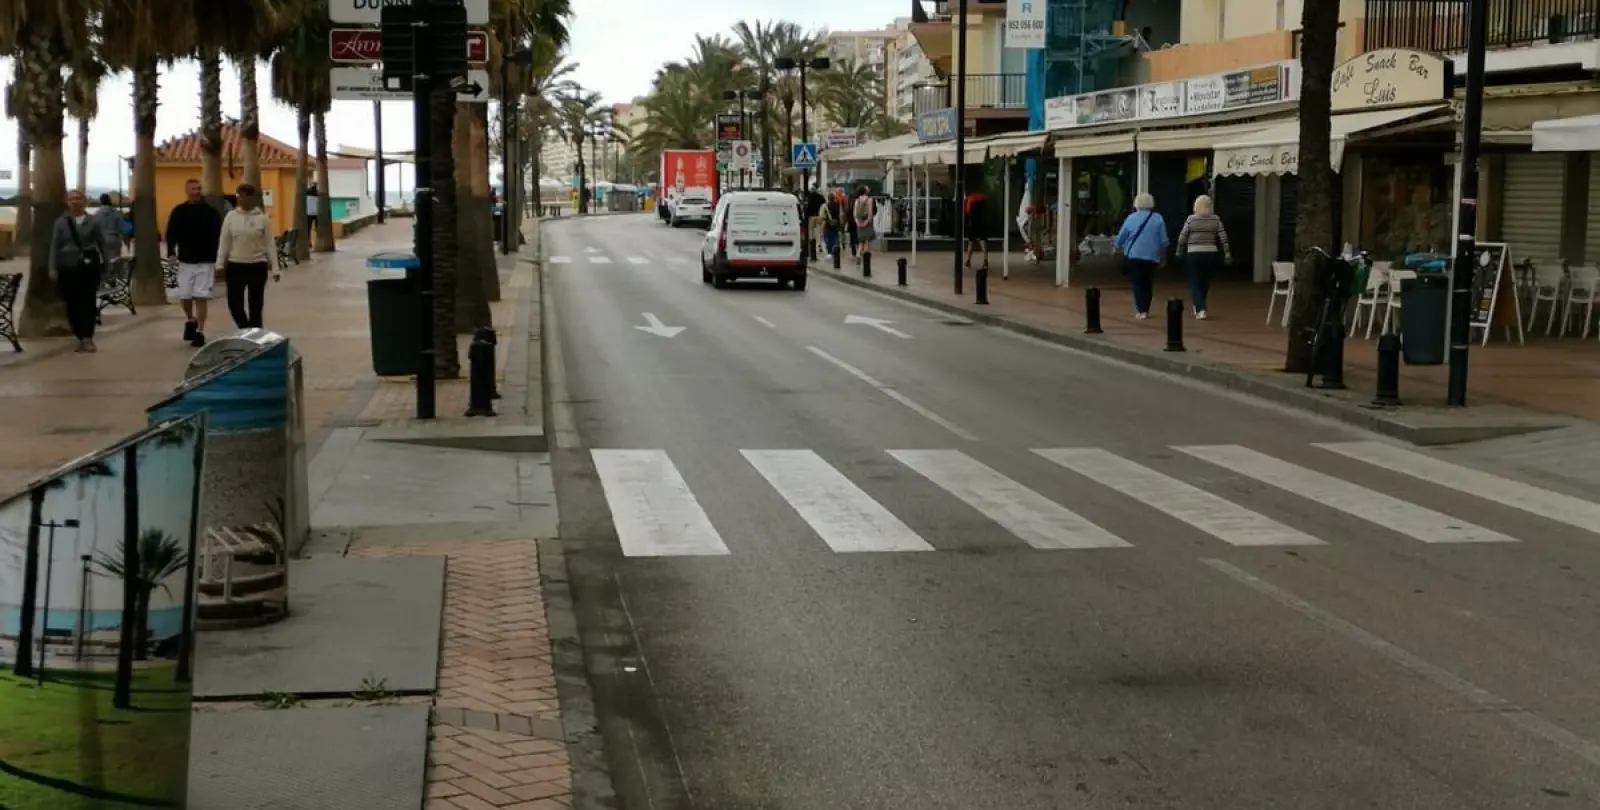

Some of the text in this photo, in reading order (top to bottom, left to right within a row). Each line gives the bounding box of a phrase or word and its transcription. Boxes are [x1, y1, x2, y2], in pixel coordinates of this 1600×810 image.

[1365, 52, 1397, 73] Snack
[1408, 54, 1429, 79] Bar
[1363, 78, 1397, 104] Luis
